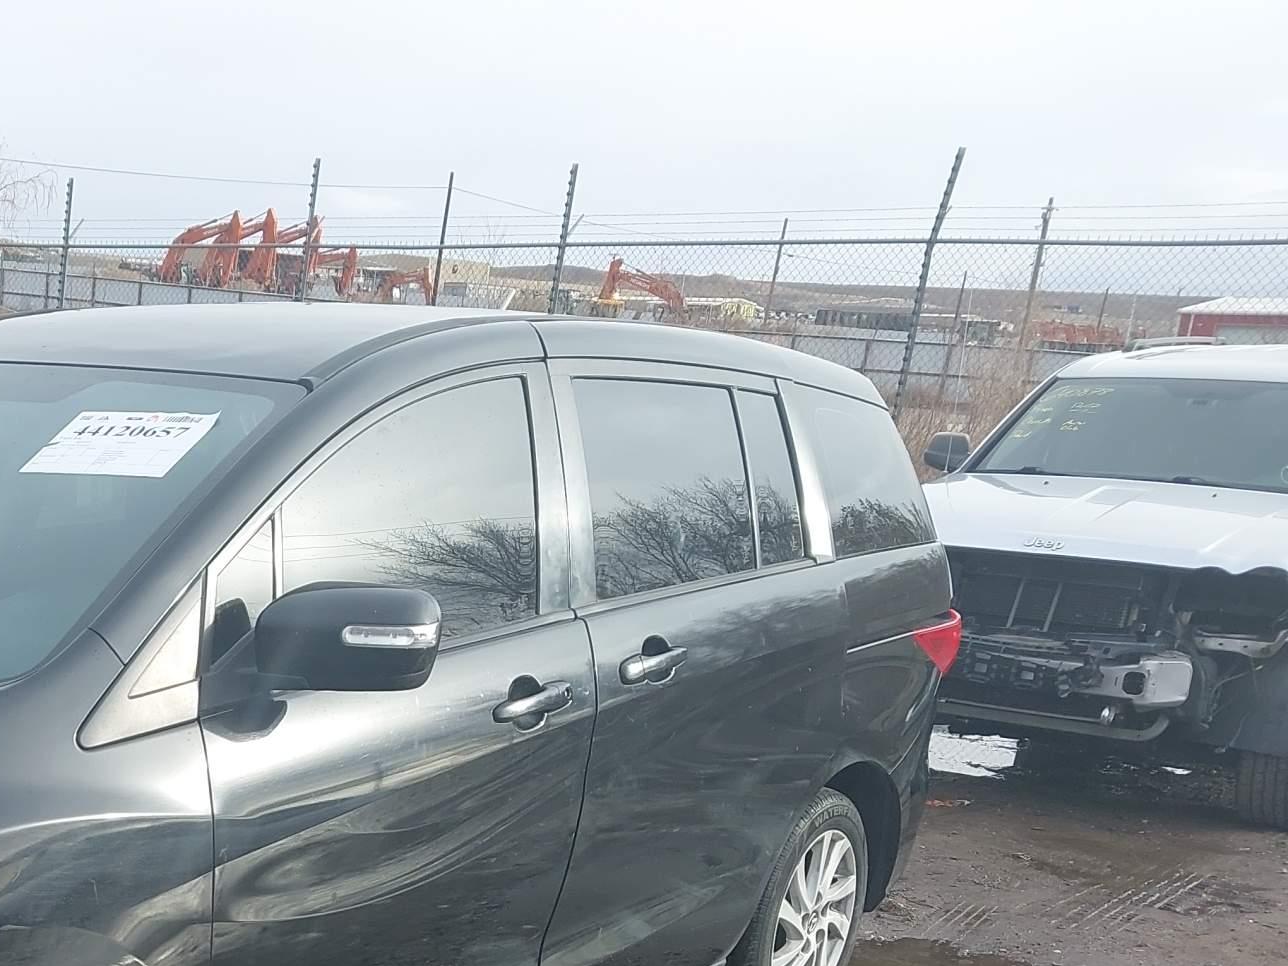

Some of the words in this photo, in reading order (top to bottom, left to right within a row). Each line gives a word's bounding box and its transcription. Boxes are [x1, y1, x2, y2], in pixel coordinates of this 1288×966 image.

[73, 425, 191, 438] 44120657
[1023, 536, 1065, 551] Jeep
[813, 805, 857, 828] WATERF
